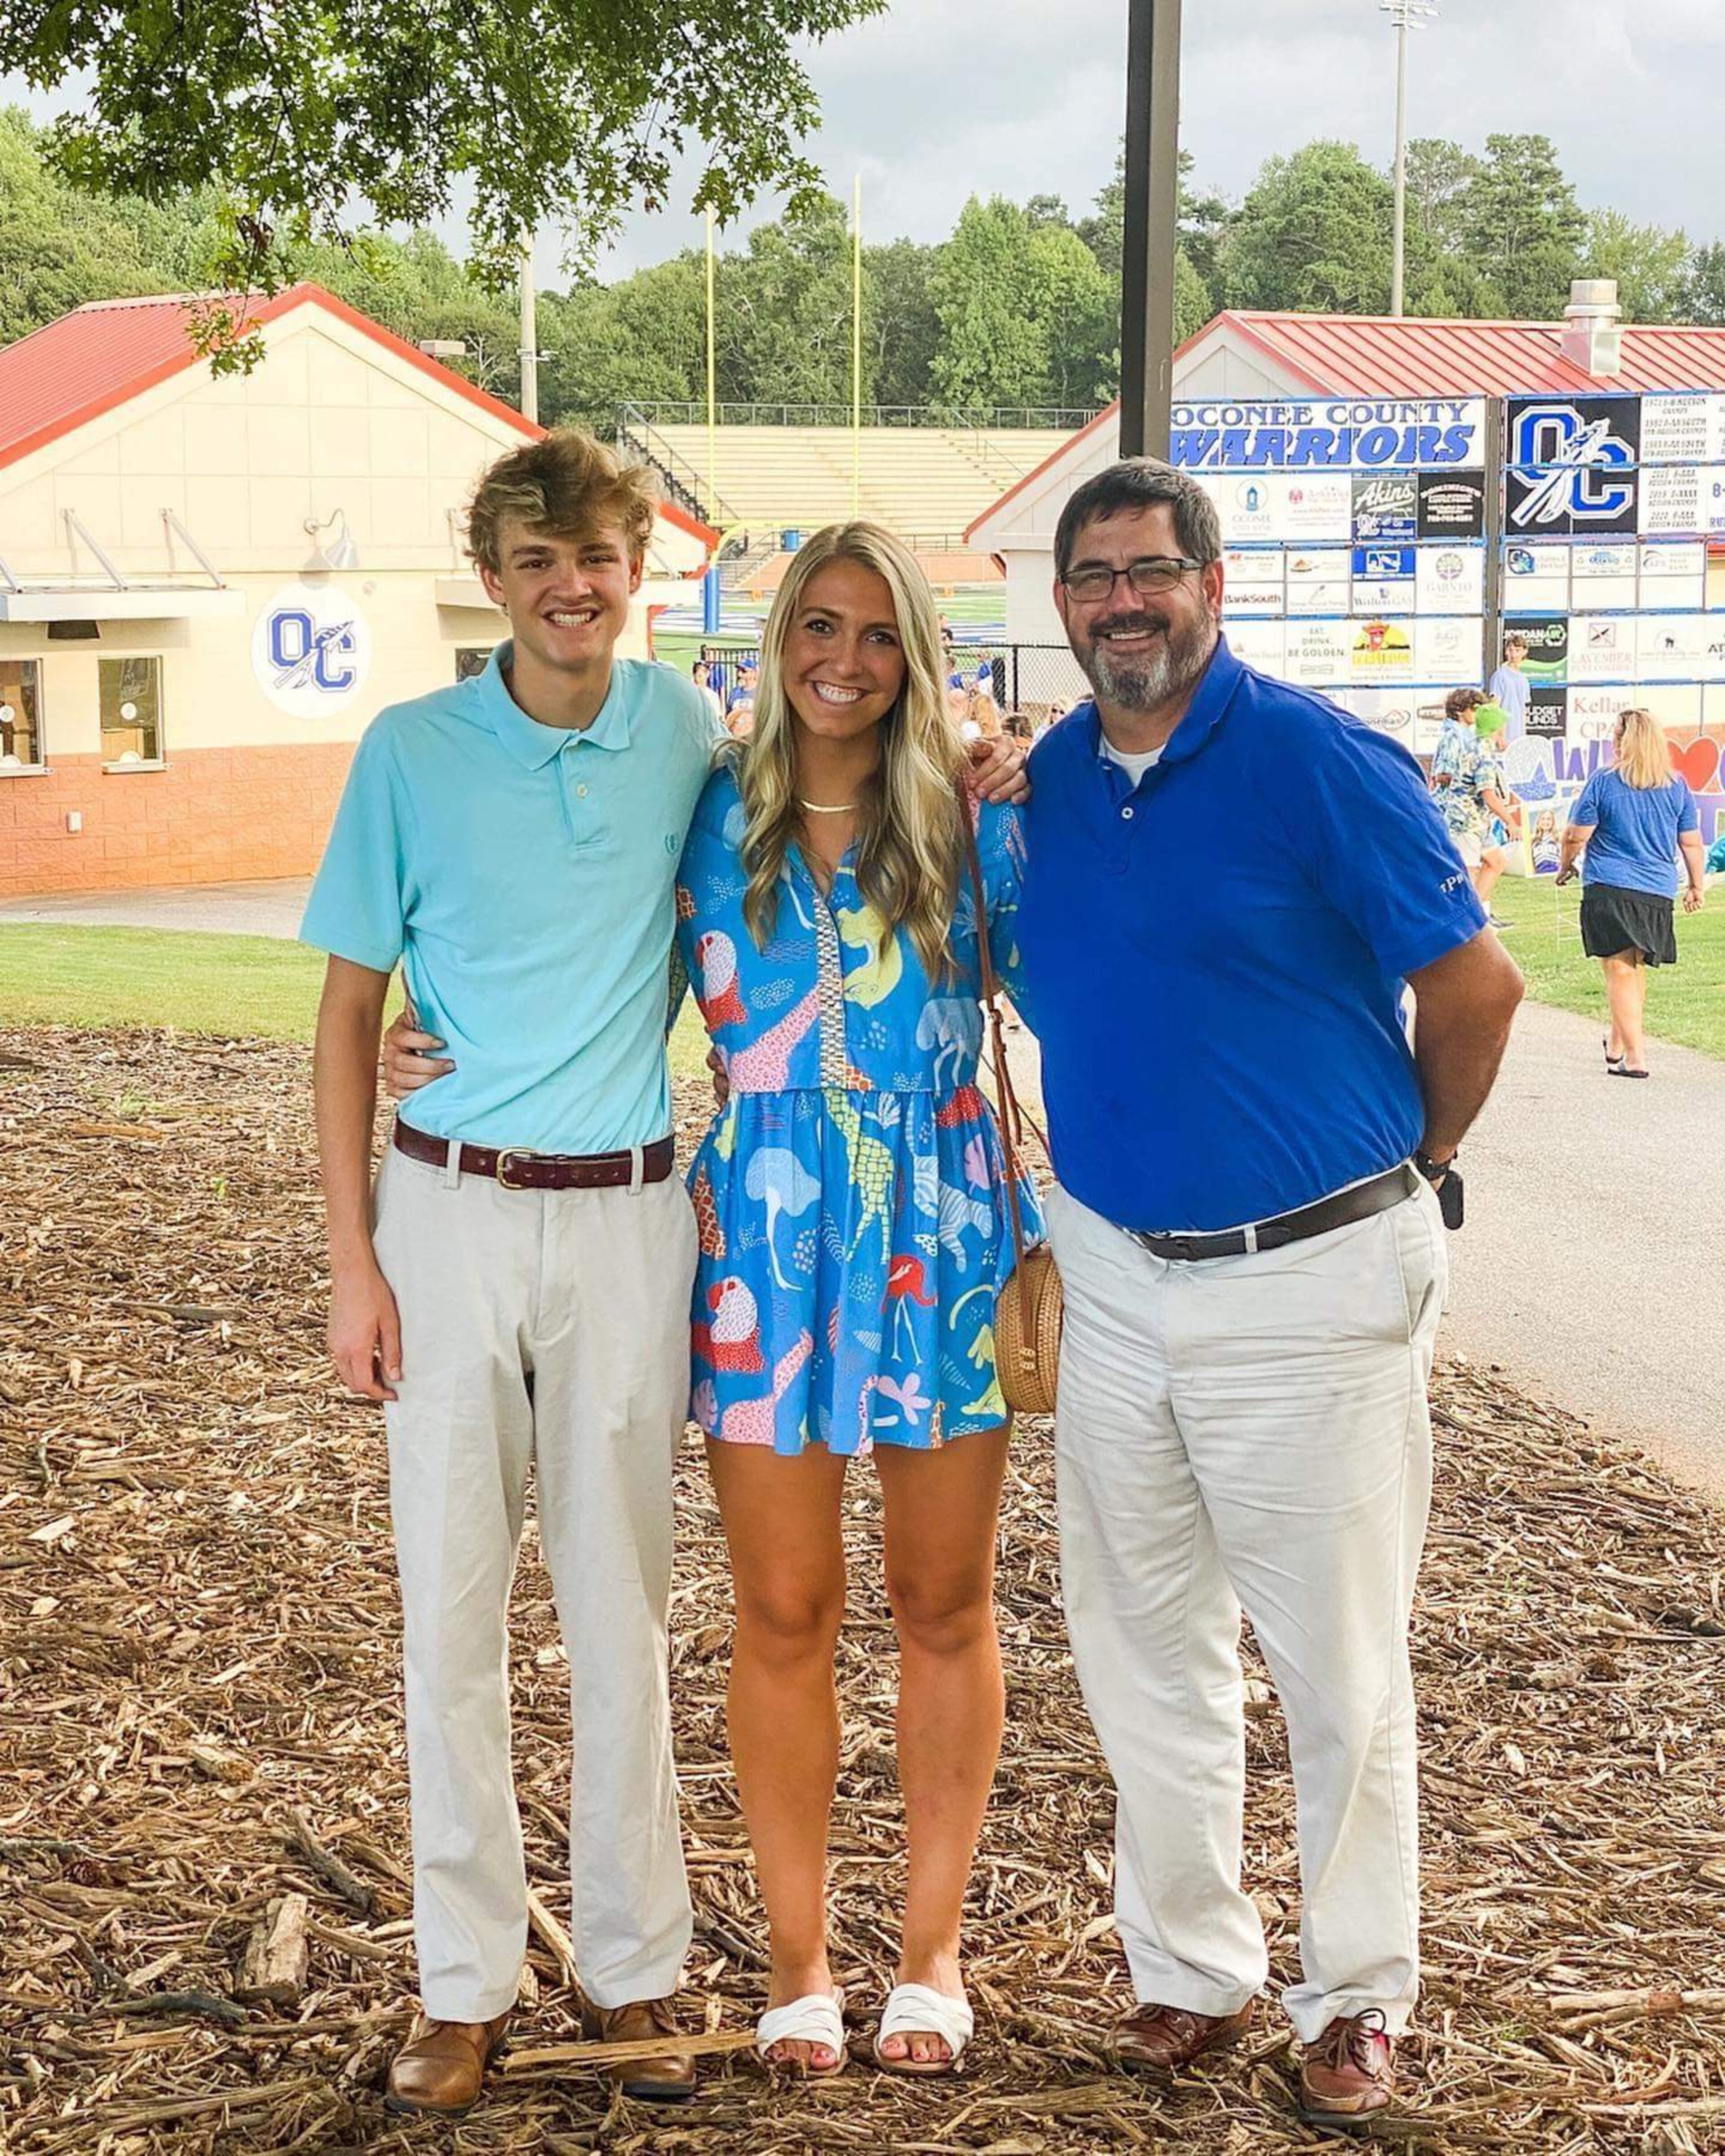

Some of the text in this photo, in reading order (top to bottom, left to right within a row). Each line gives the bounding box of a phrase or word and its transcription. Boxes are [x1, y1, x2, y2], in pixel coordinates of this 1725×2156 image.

[1170, 402, 1468, 426] OCONEE COUNTY
[1170, 425, 1476, 466] WARRIORS
[1353, 482, 1415, 509] Akins
[1224, 594, 1282, 604] BankSouth
[268, 608, 356, 693] OC
[1572, 653, 1632, 663] LAVENDER
[1574, 697, 1629, 713] Kellar
